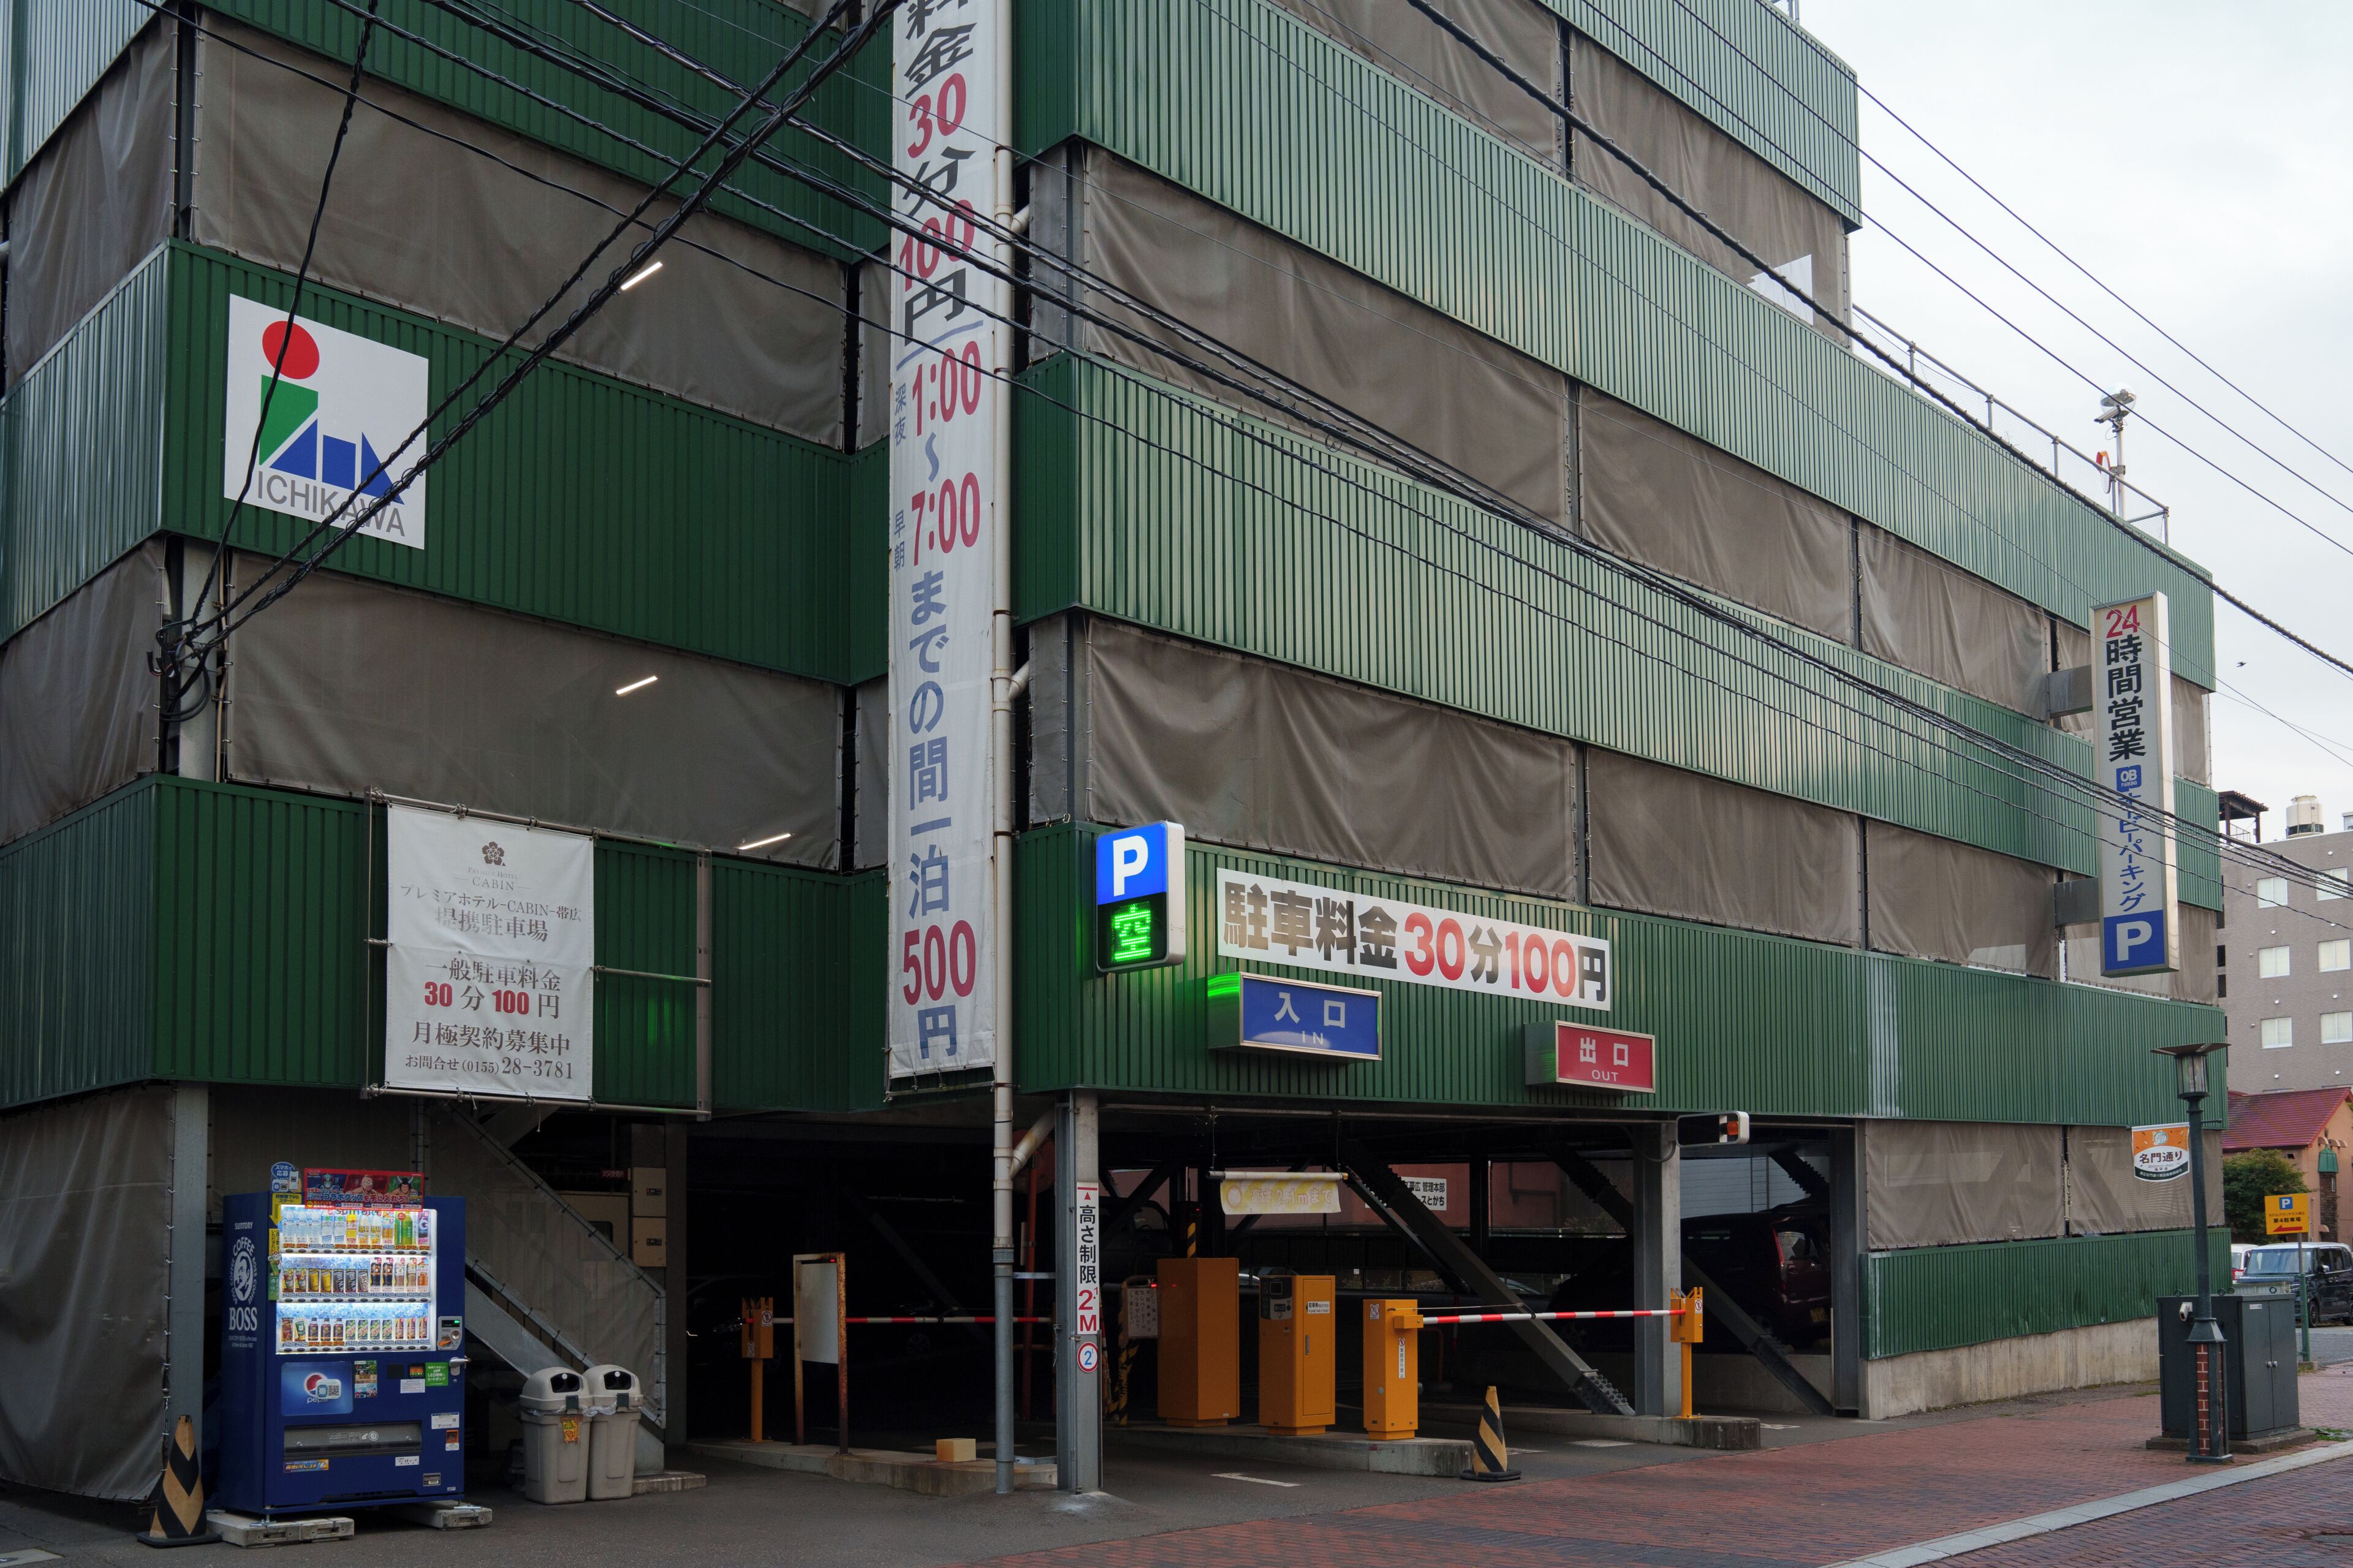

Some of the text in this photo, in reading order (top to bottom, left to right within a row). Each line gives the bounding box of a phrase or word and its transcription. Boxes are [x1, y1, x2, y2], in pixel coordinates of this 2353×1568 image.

[895, 382, 907, 449] 深夜
[258, 471, 406, 537] ICHIKAWA
[894, 509, 906, 572] 早朝
[2105, 605, 2146, 762] 24時間営業
[2120, 769, 2137, 782] OB
[1113, 835, 1149, 897] P
[2118, 792, 2146, 912] オービーパーキング
[472, 876, 515, 891] CABIN
[497, 871, 519, 880] HOTEL
[434, 905, 549, 943] 提携駐車場
[1113, 901, 1151, 961] 空
[1223, 881, 1607, 1002] 駐車料金30分100円
[2116, 920, 2152, 961] P
[425, 957, 561, 993] 一般駐車料金
[1274, 992, 1346, 1028] 入口
[412, 1021, 570, 1057] 月極契約募集中
[1302, 1030, 1324, 1045] IN
[1580, 1037, 1629, 1067] 出口
[1591, 1069, 1618, 1082] OUT
[2139, 1151, 2182, 1164] 名門通り
[1405, 1181, 1445, 1192] 帯広 管理本部
[2281, 1199, 2290, 1208] P
[233, 1237, 255, 1256] COFFEE
[229, 1306, 257, 1331] BOSS
